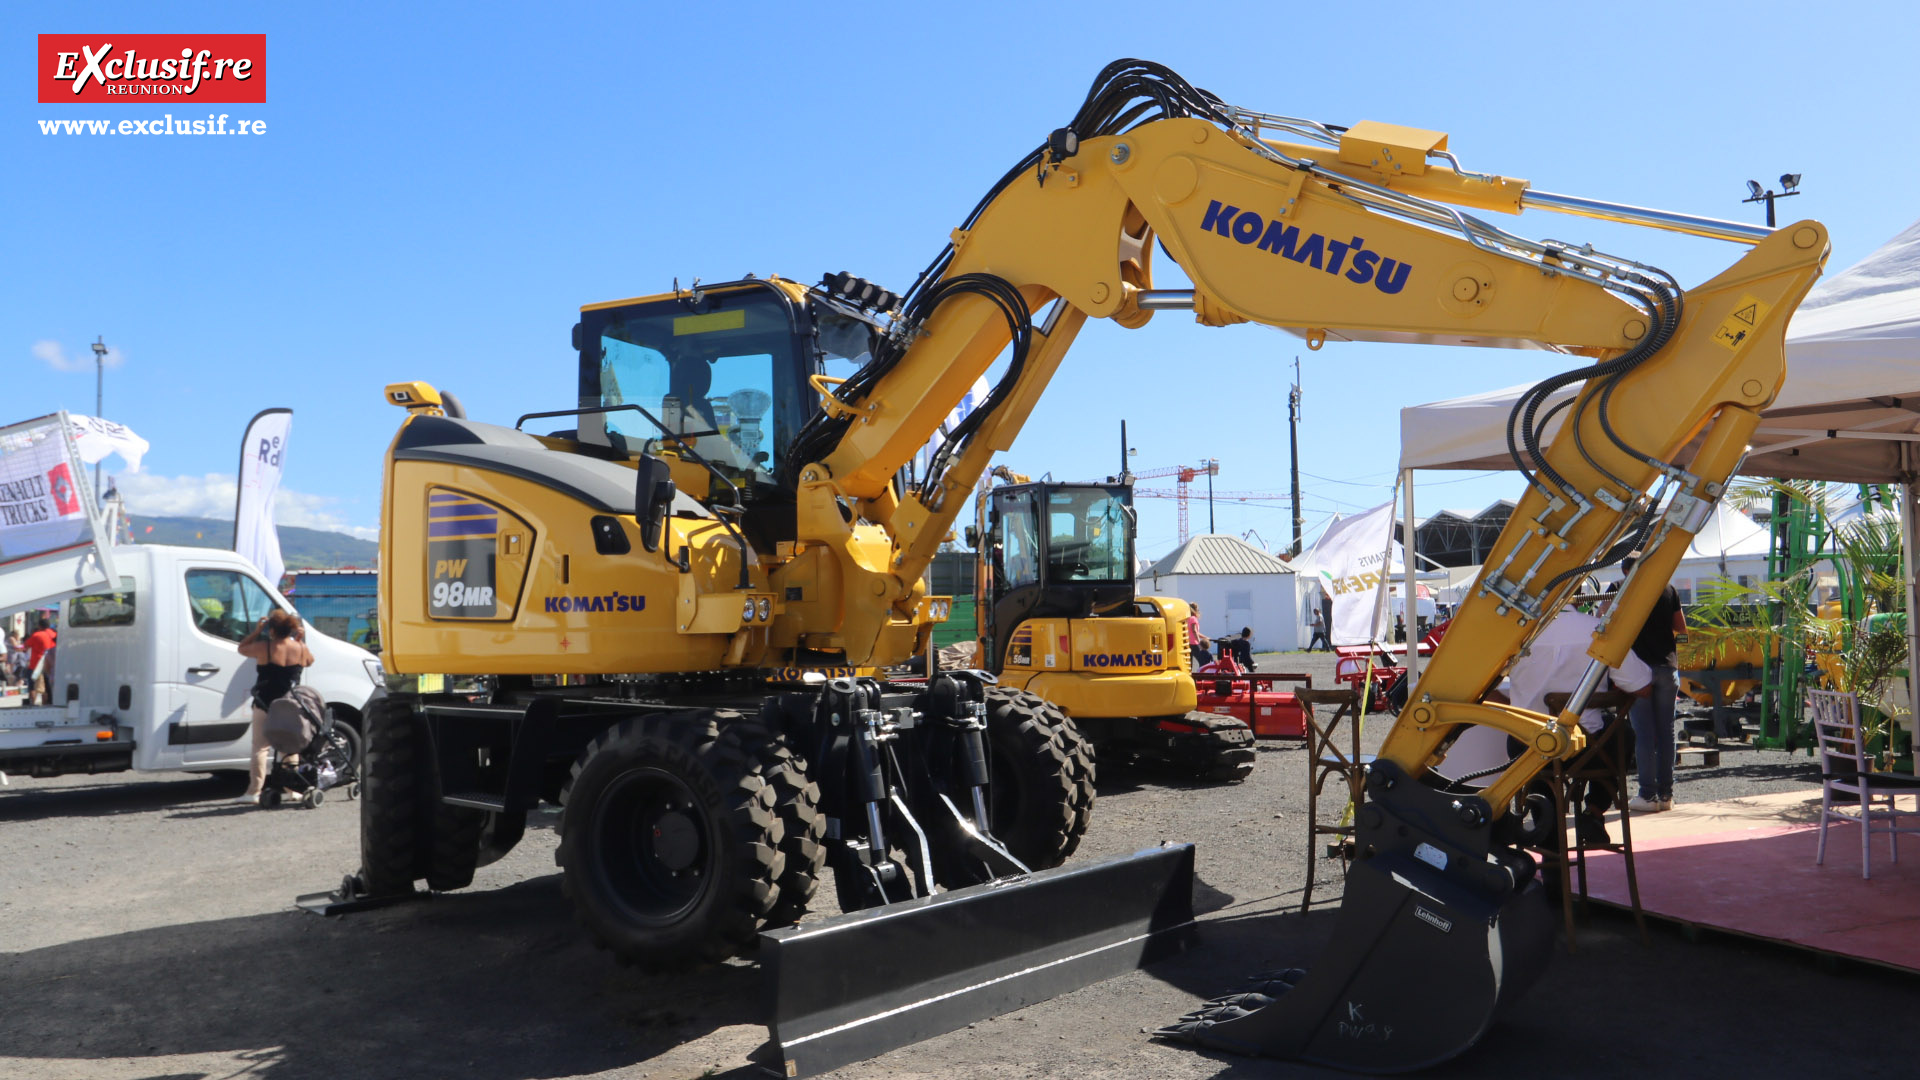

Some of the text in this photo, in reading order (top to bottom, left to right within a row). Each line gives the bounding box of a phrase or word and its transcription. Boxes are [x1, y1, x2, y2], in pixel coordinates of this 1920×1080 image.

[1200, 199, 1412, 295] KOMATSU
[0, 500, 49, 526] TRUCKS
[434, 559, 468, 579] PW
[432, 582, 493, 607] 98MR
[545, 591, 646, 612] KOMATSU
[1083, 650, 1162, 667] KOMATSU
[775, 667, 856, 680] KOATSU
[1417, 908, 1450, 930] Lehnhoff
[1347, 1000, 1363, 1021] K
